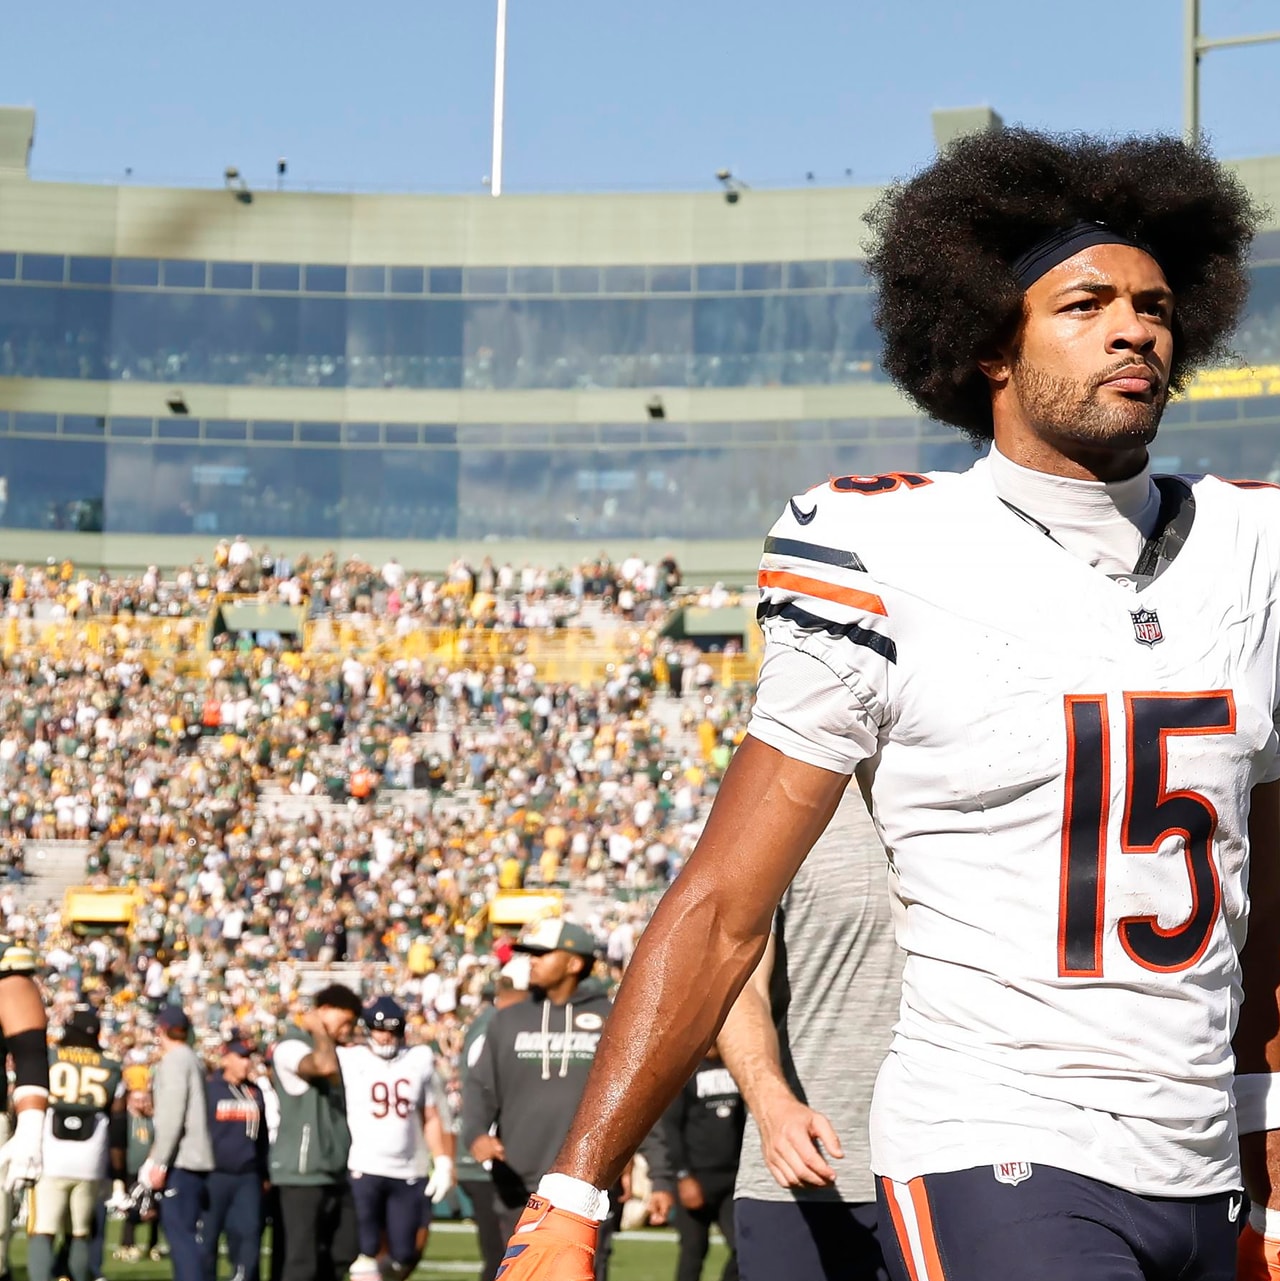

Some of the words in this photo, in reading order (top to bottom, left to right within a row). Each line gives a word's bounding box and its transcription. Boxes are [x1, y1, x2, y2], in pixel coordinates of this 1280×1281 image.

[1136, 622, 1162, 641] NFL
[1057, 688, 1236, 978] 15
[49, 1060, 110, 1108] 95
[371, 1078, 411, 1119] 96
[999, 1160, 1026, 1178] NFL
